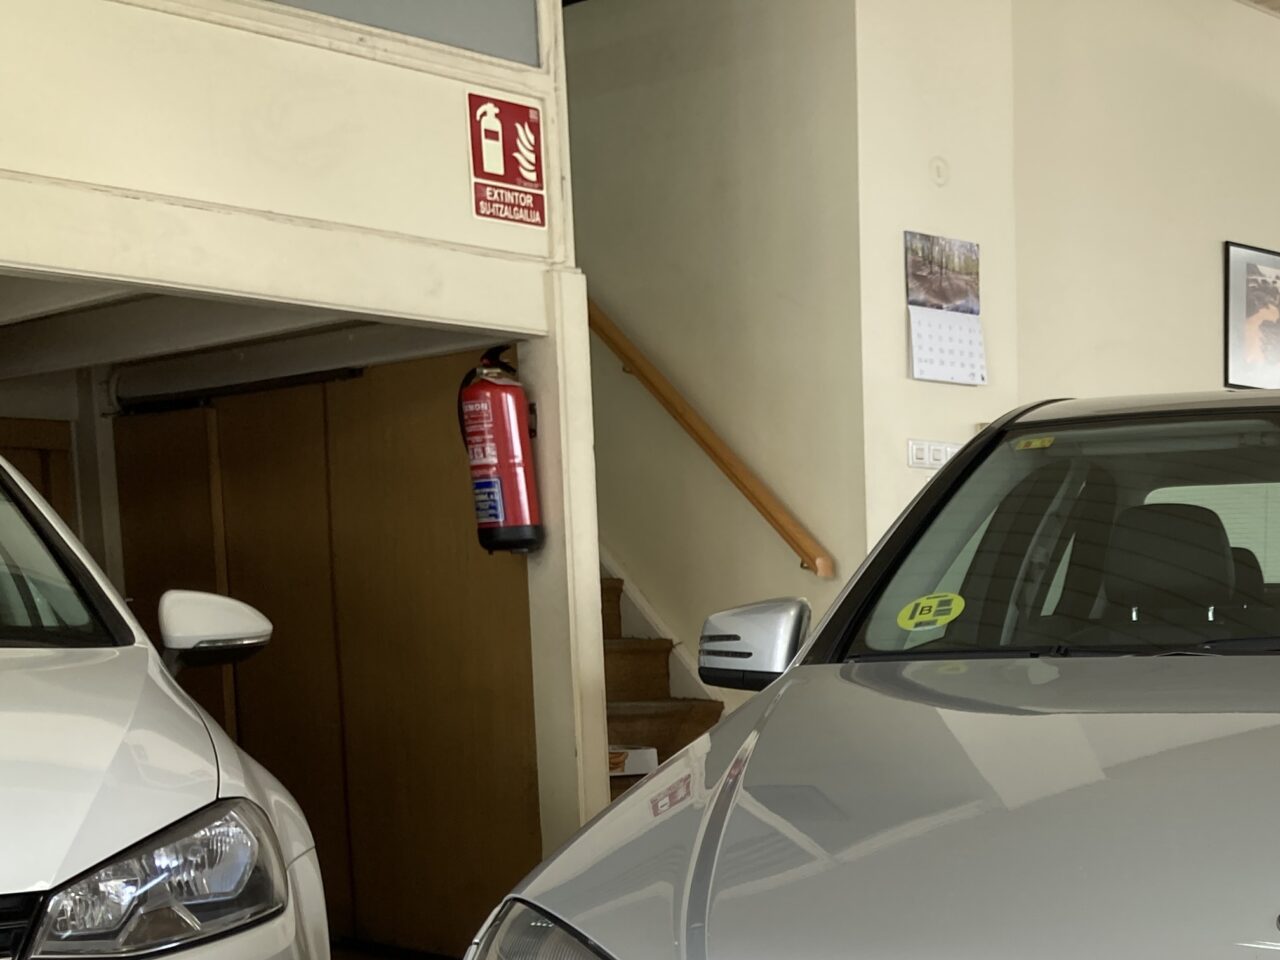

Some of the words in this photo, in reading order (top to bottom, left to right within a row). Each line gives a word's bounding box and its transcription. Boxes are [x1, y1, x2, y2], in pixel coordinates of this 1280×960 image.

[486, 187, 533, 207] EXTINTOR
[479, 200, 541, 223] SU-ITZALGAILUA
[919, 606, 932, 615] B
